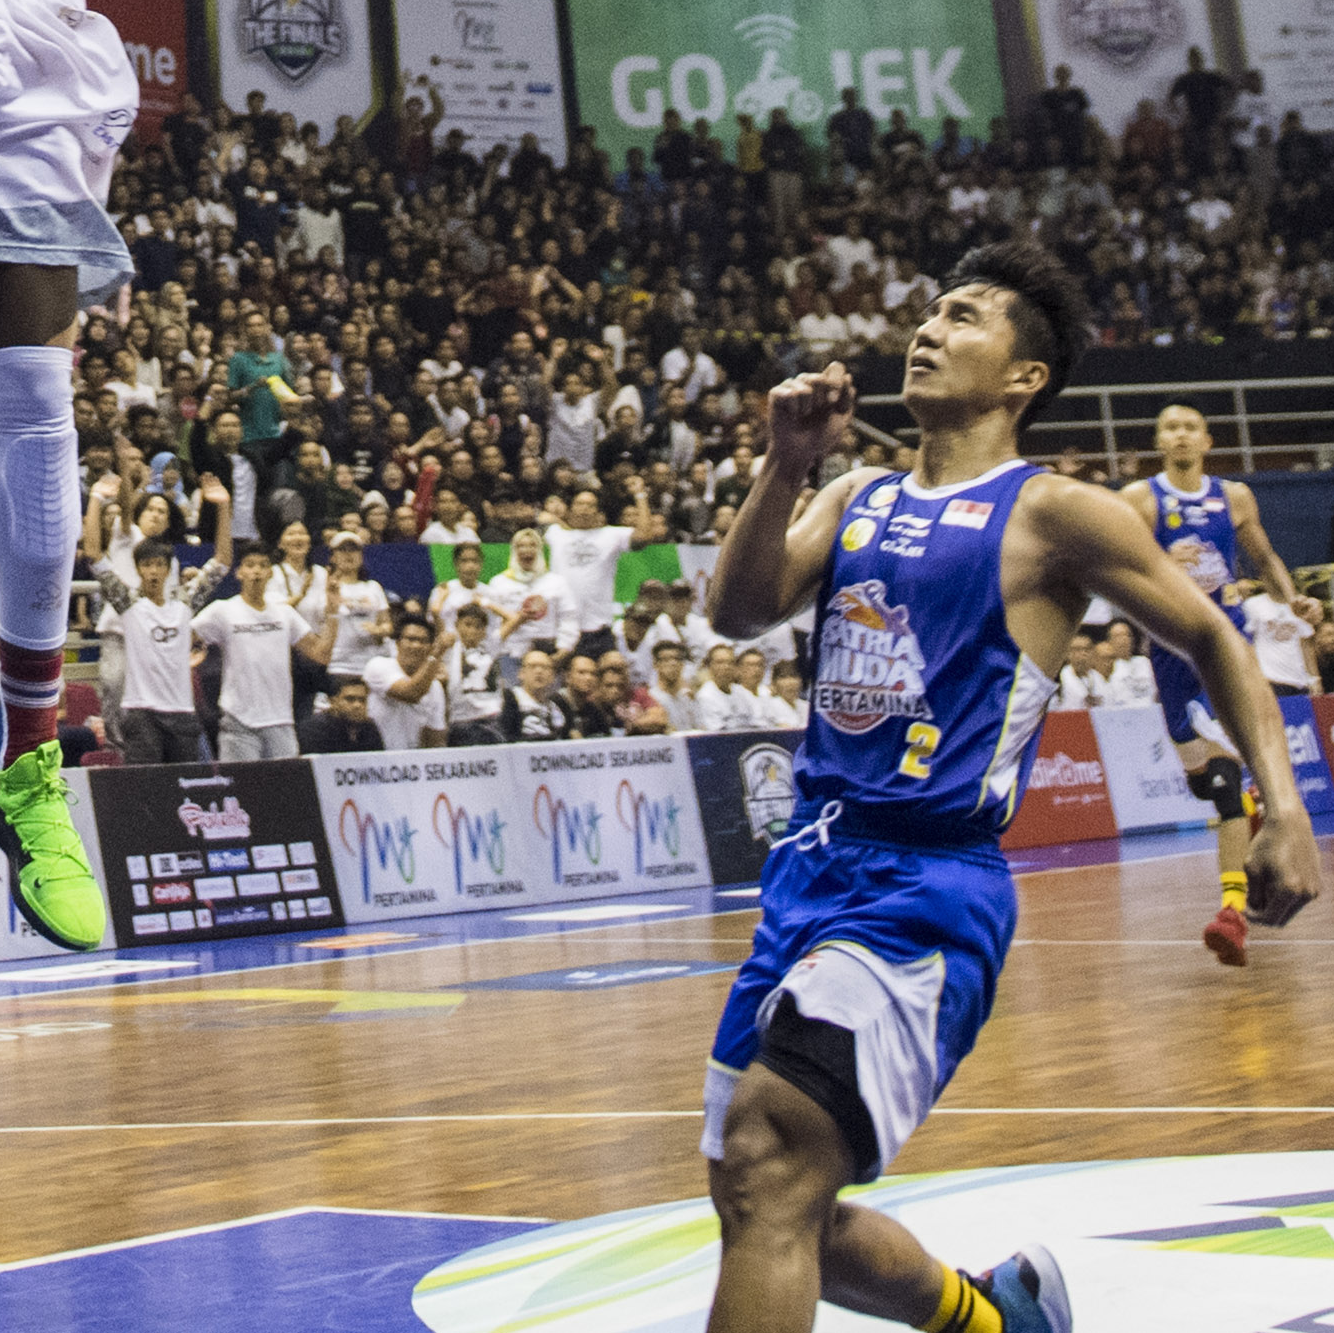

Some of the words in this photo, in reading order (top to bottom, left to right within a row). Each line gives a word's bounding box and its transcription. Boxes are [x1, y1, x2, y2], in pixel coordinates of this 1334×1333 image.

[245, 20, 280, 53] THE
[281, 21, 344, 56] FINALS
[611, 53, 728, 129] GO
[817, 687, 934, 721] ERTAMINA
[529, 751, 605, 774] DOWNLOAD
[609, 746, 675, 769] SEKARANG
[898, 720, 942, 779] 2
[334, 764, 421, 787] DOWNLOAD
[425, 759, 499, 783] SEKARANG
